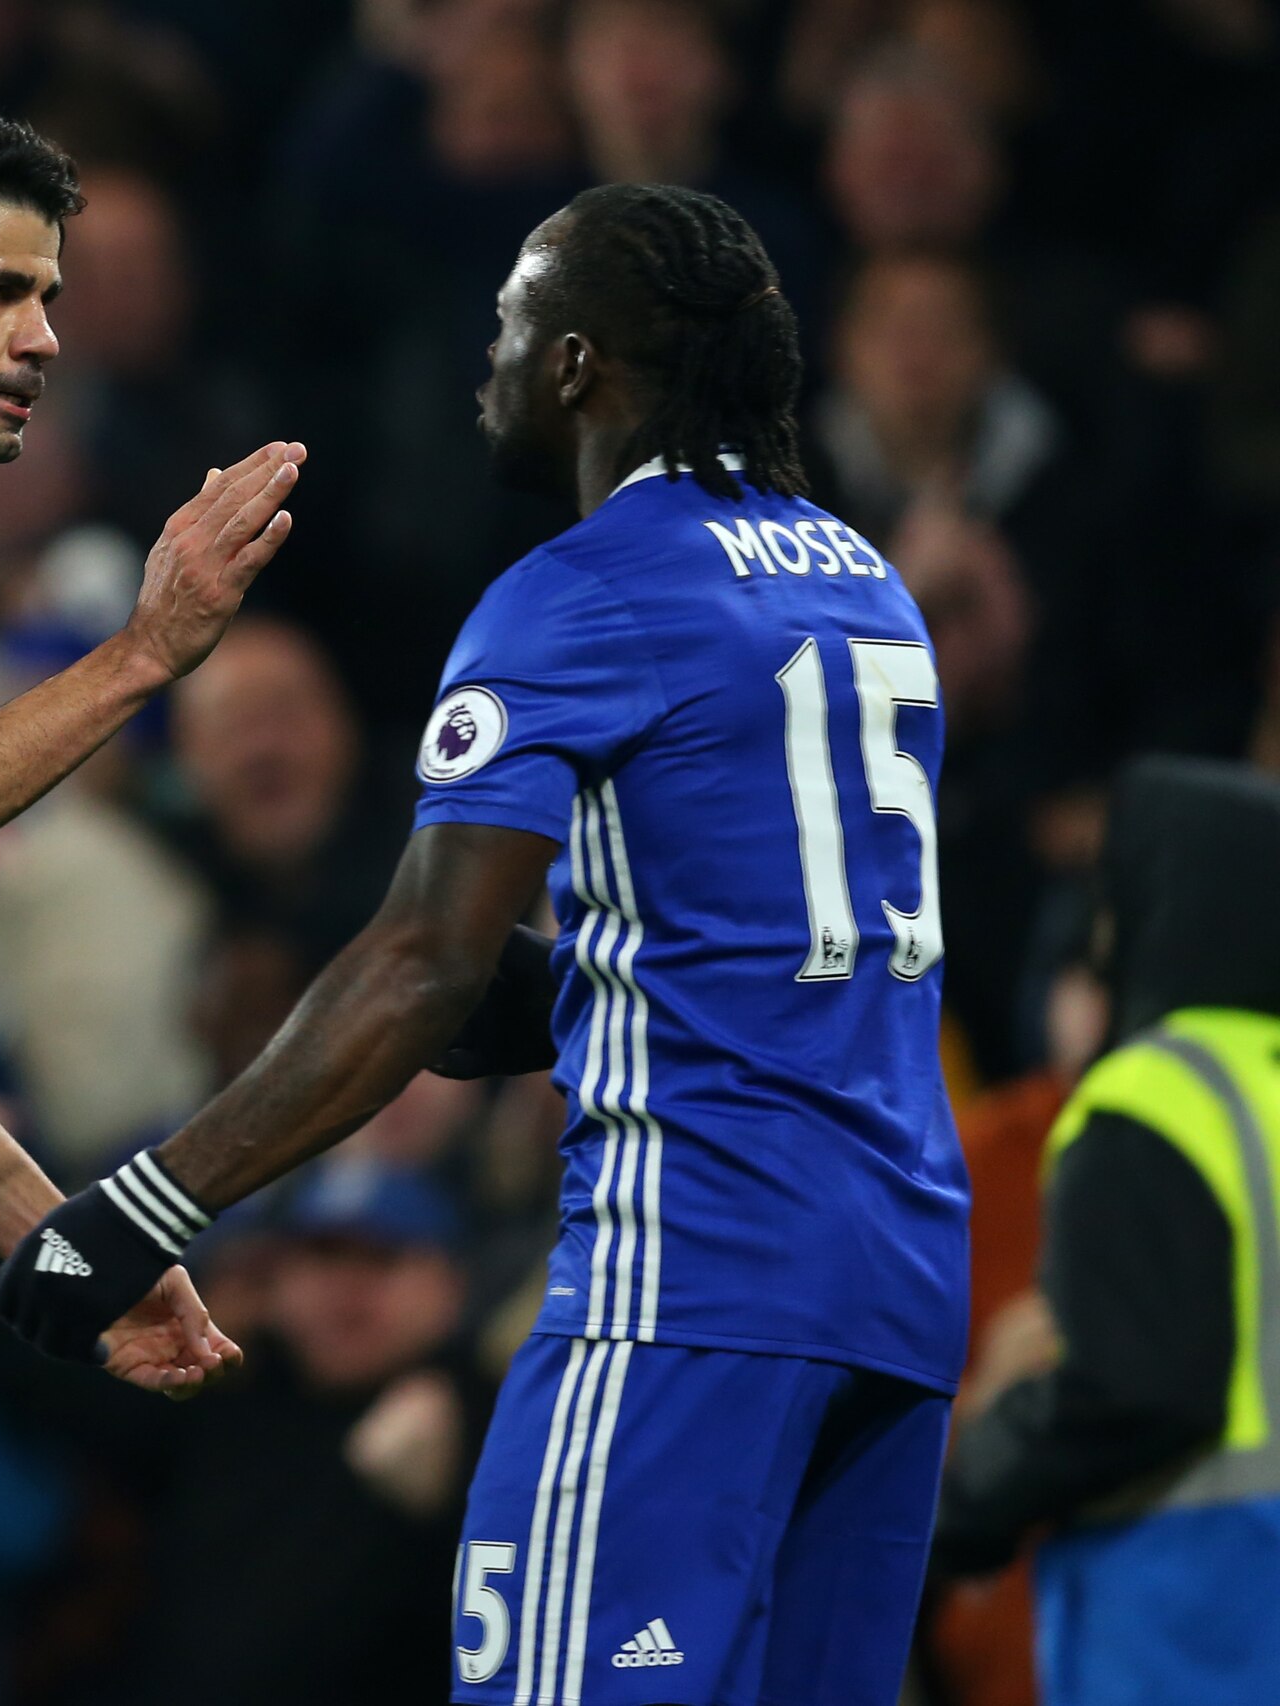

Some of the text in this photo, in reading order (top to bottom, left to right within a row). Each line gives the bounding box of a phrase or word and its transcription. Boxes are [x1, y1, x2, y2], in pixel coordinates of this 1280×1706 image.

[703, 518, 888, 580] MOSES
[775, 636, 945, 982] 15
[40, 1227, 94, 1277] adidas
[451, 1540, 517, 1684] 5
[611, 1650, 685, 1668] adidas
